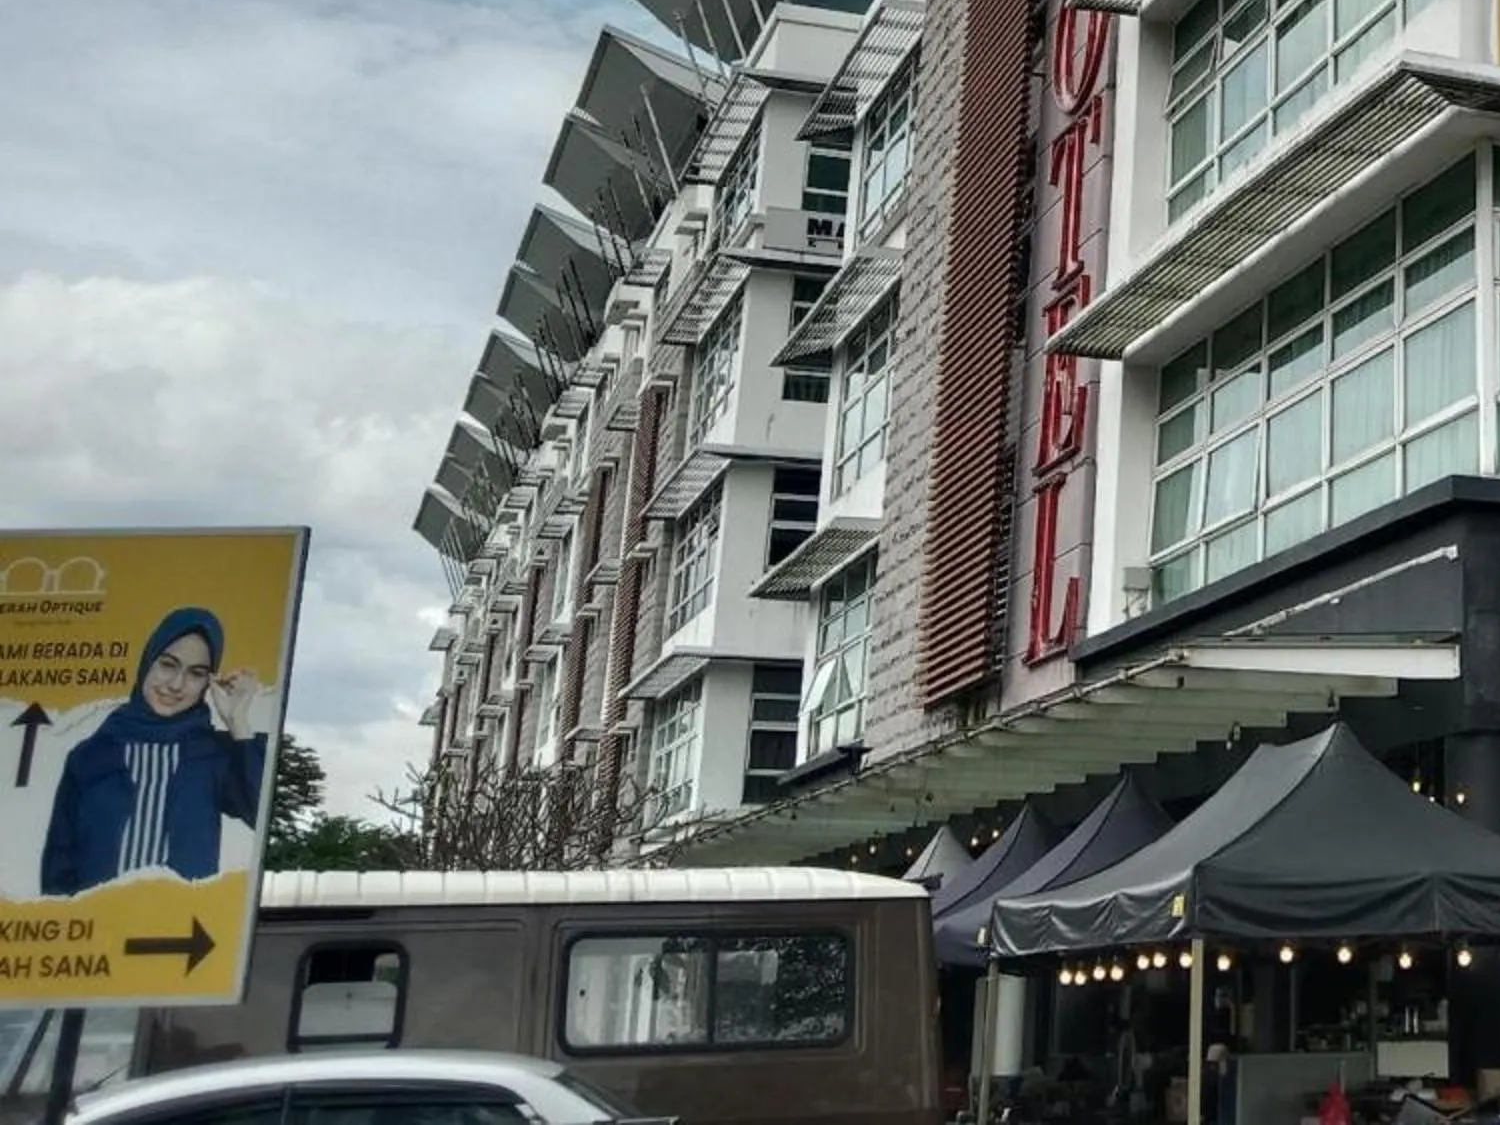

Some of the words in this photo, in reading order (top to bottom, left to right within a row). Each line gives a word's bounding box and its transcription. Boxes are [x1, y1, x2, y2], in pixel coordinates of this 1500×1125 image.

[33, 641, 103, 659] BERADA
[109, 640, 129, 658] DI
[76, 667, 127, 685] SANA
[68, 918, 94, 941] DI
[39, 955, 111, 979] SANA
